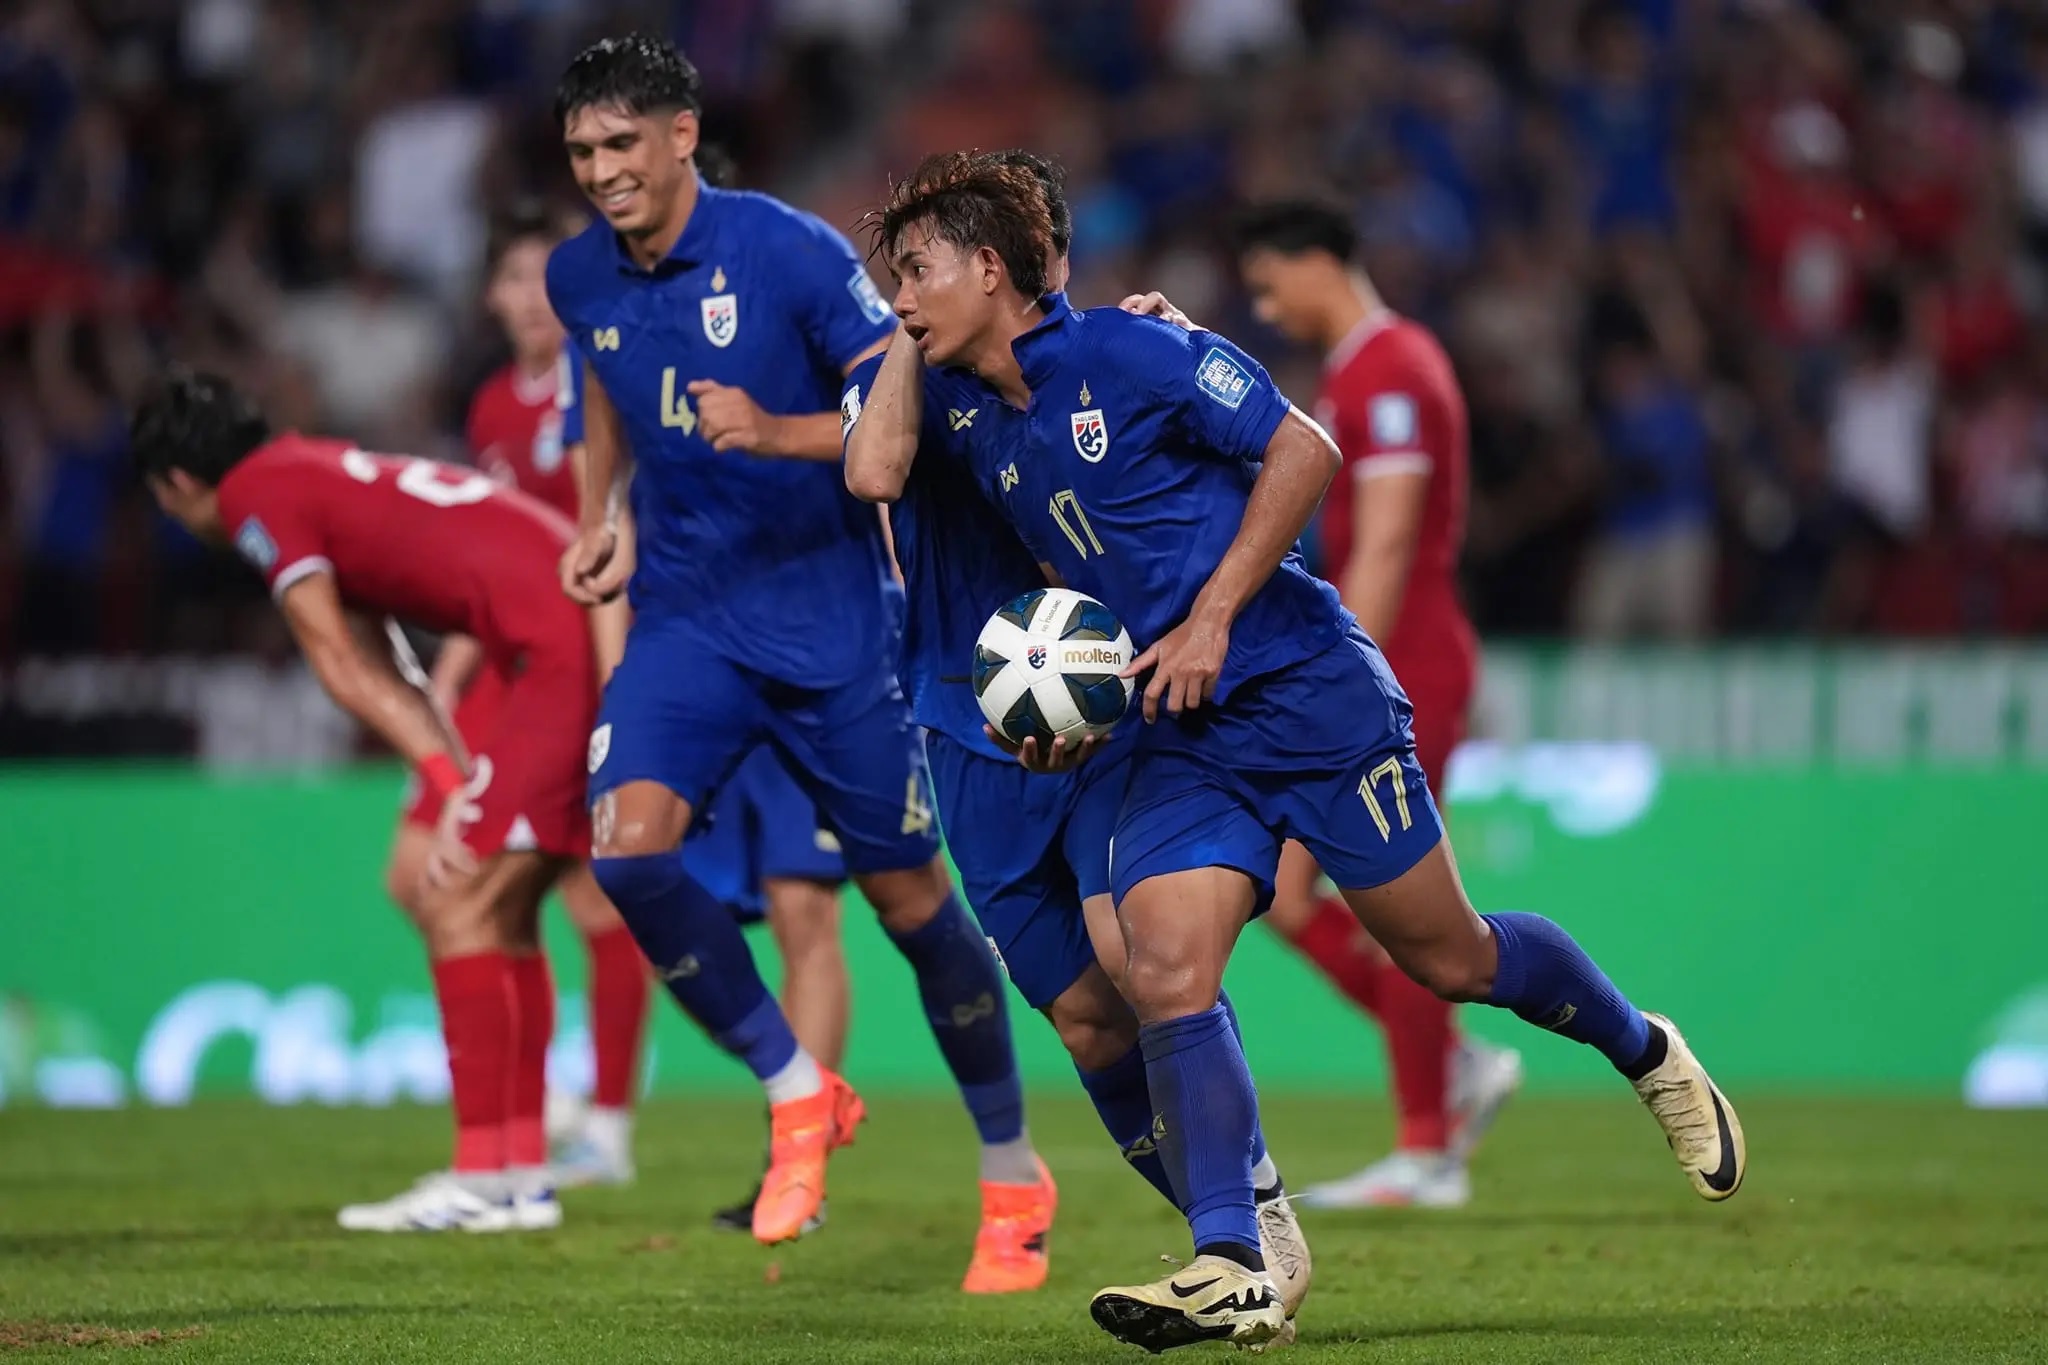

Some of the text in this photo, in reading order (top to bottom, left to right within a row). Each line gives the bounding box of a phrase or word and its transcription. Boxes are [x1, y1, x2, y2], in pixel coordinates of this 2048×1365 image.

[661, 366, 697, 437] 4
[1048, 488, 1105, 560] 17
[1064, 648, 1121, 665] molten
[1356, 754, 1413, 844] 17
